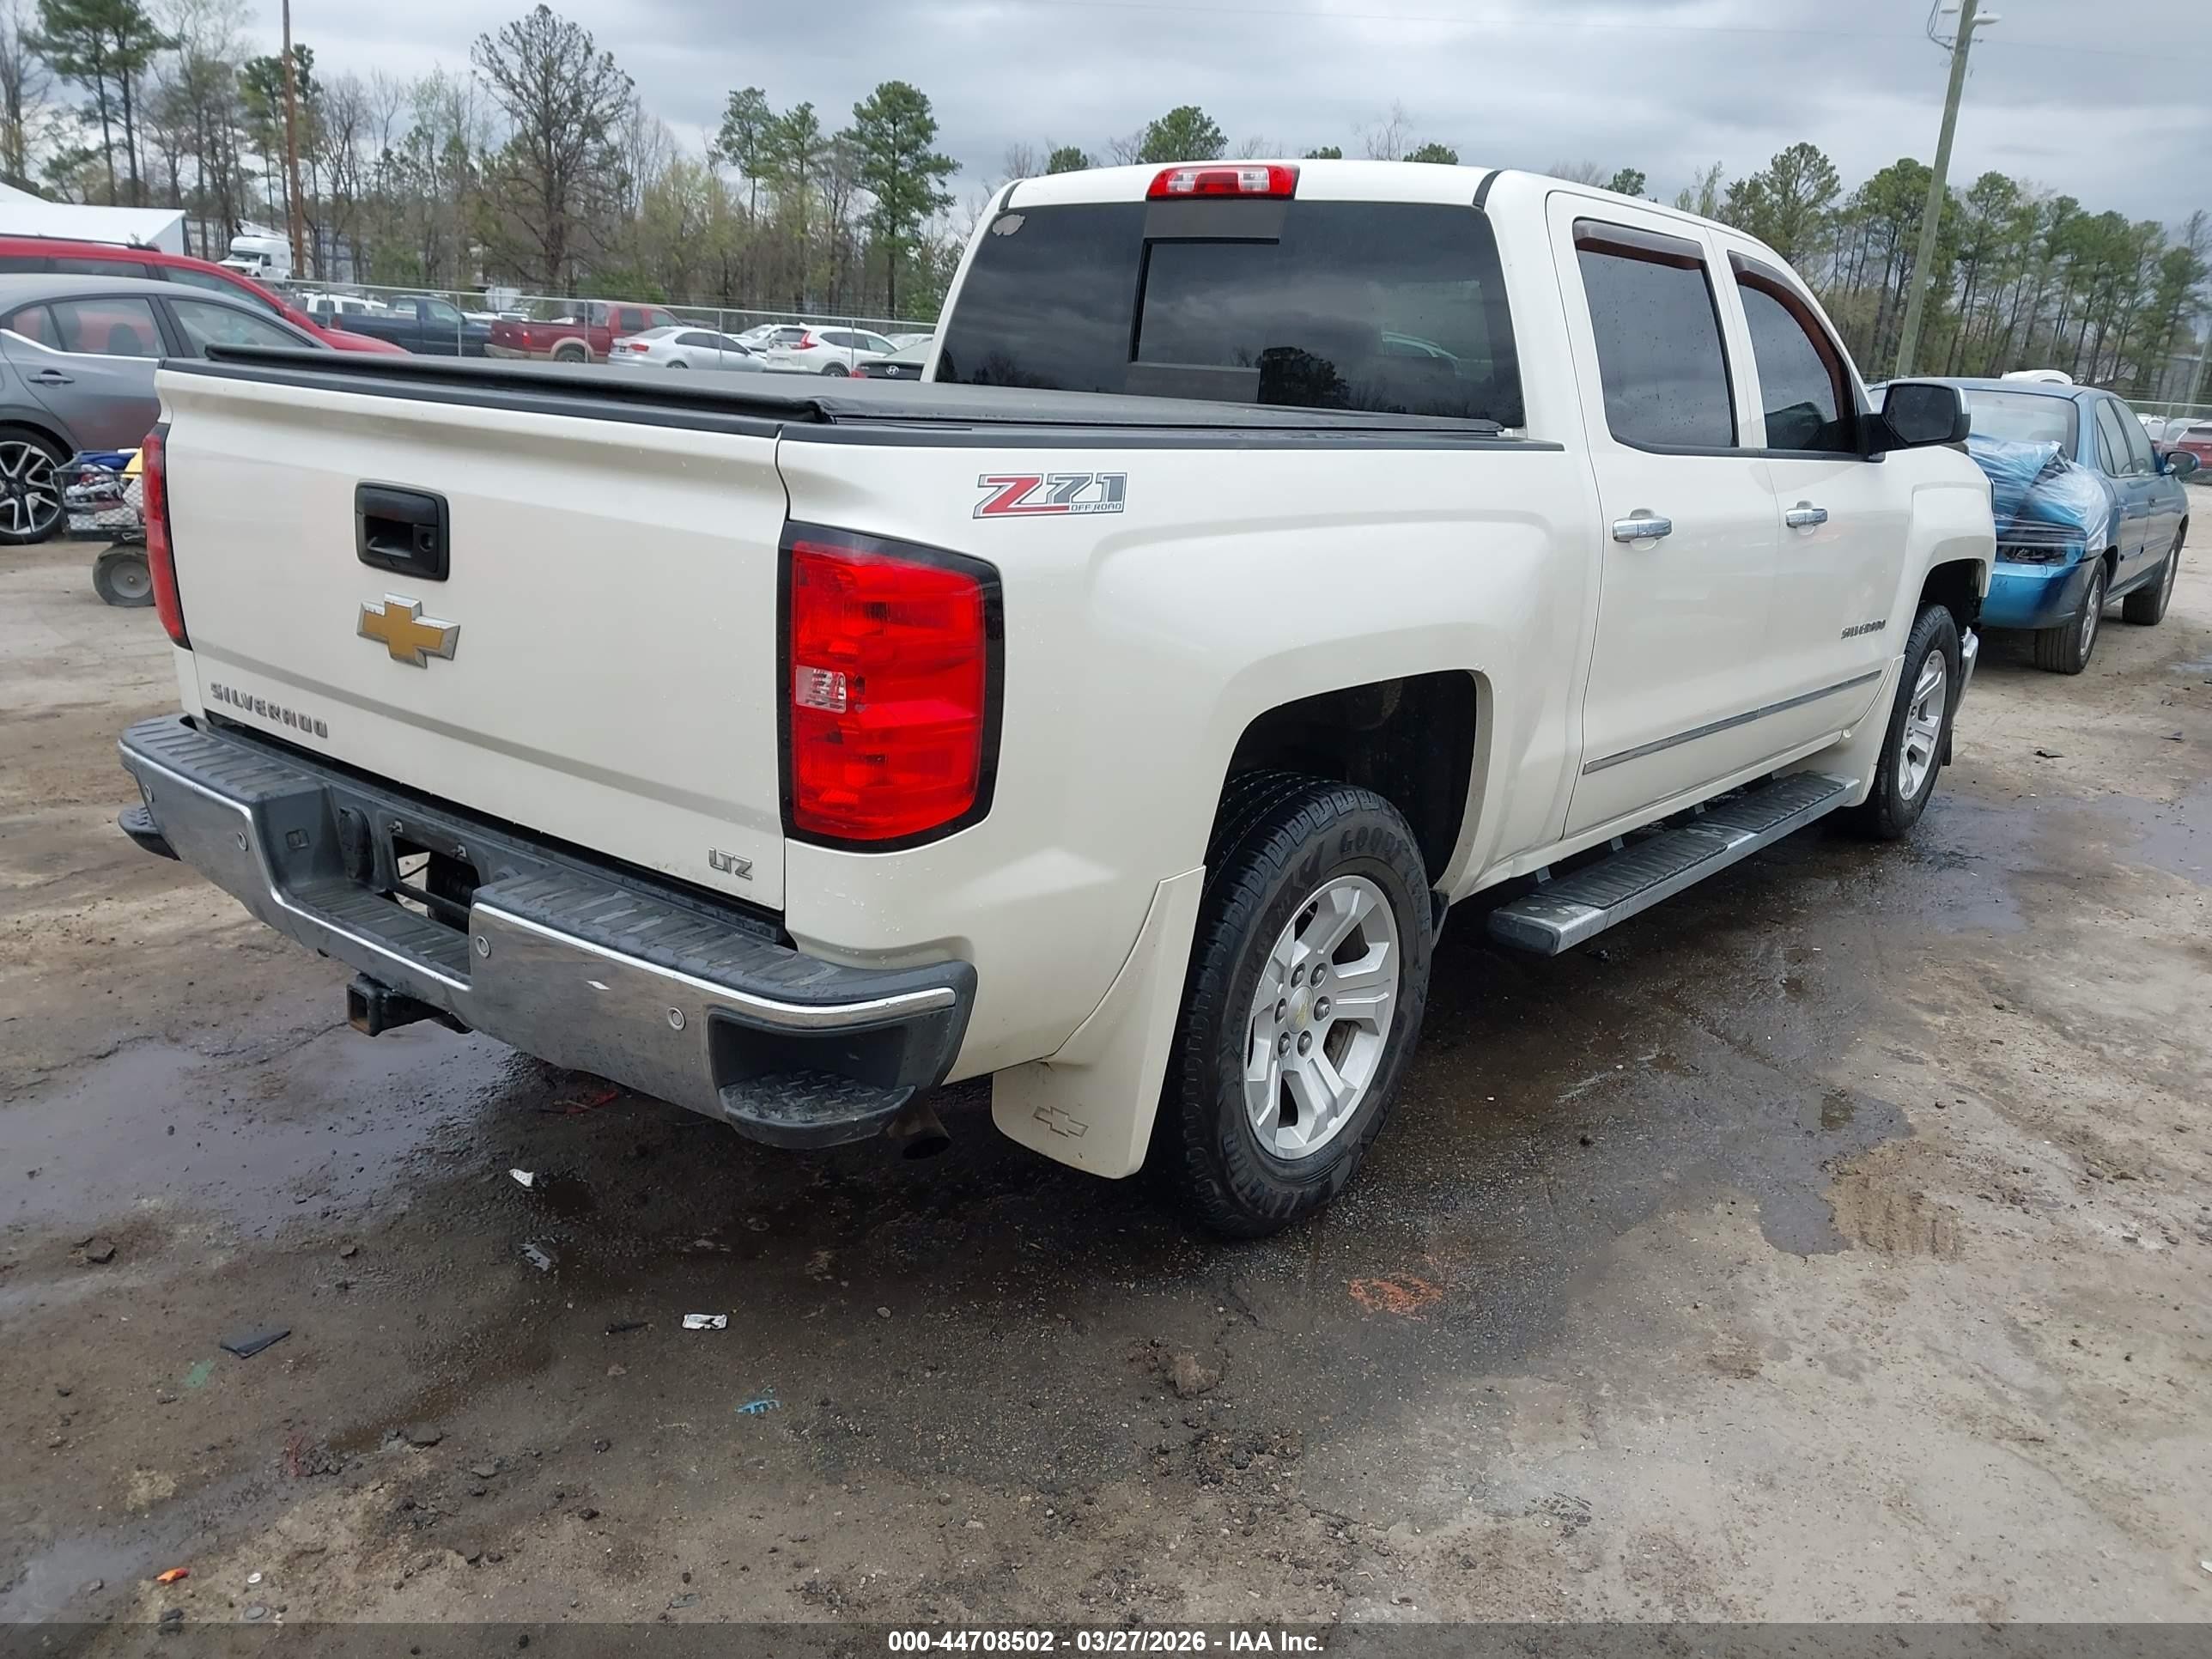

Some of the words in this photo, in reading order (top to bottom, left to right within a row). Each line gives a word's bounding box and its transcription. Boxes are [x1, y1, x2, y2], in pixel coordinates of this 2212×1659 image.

[972, 472, 1127, 519] Z71
[1071, 503, 1091, 512] OFF
[1092, 502, 1122, 511] ROAD
[210, 682, 329, 739] SILVERADO
[708, 847, 753, 881] LTZ
